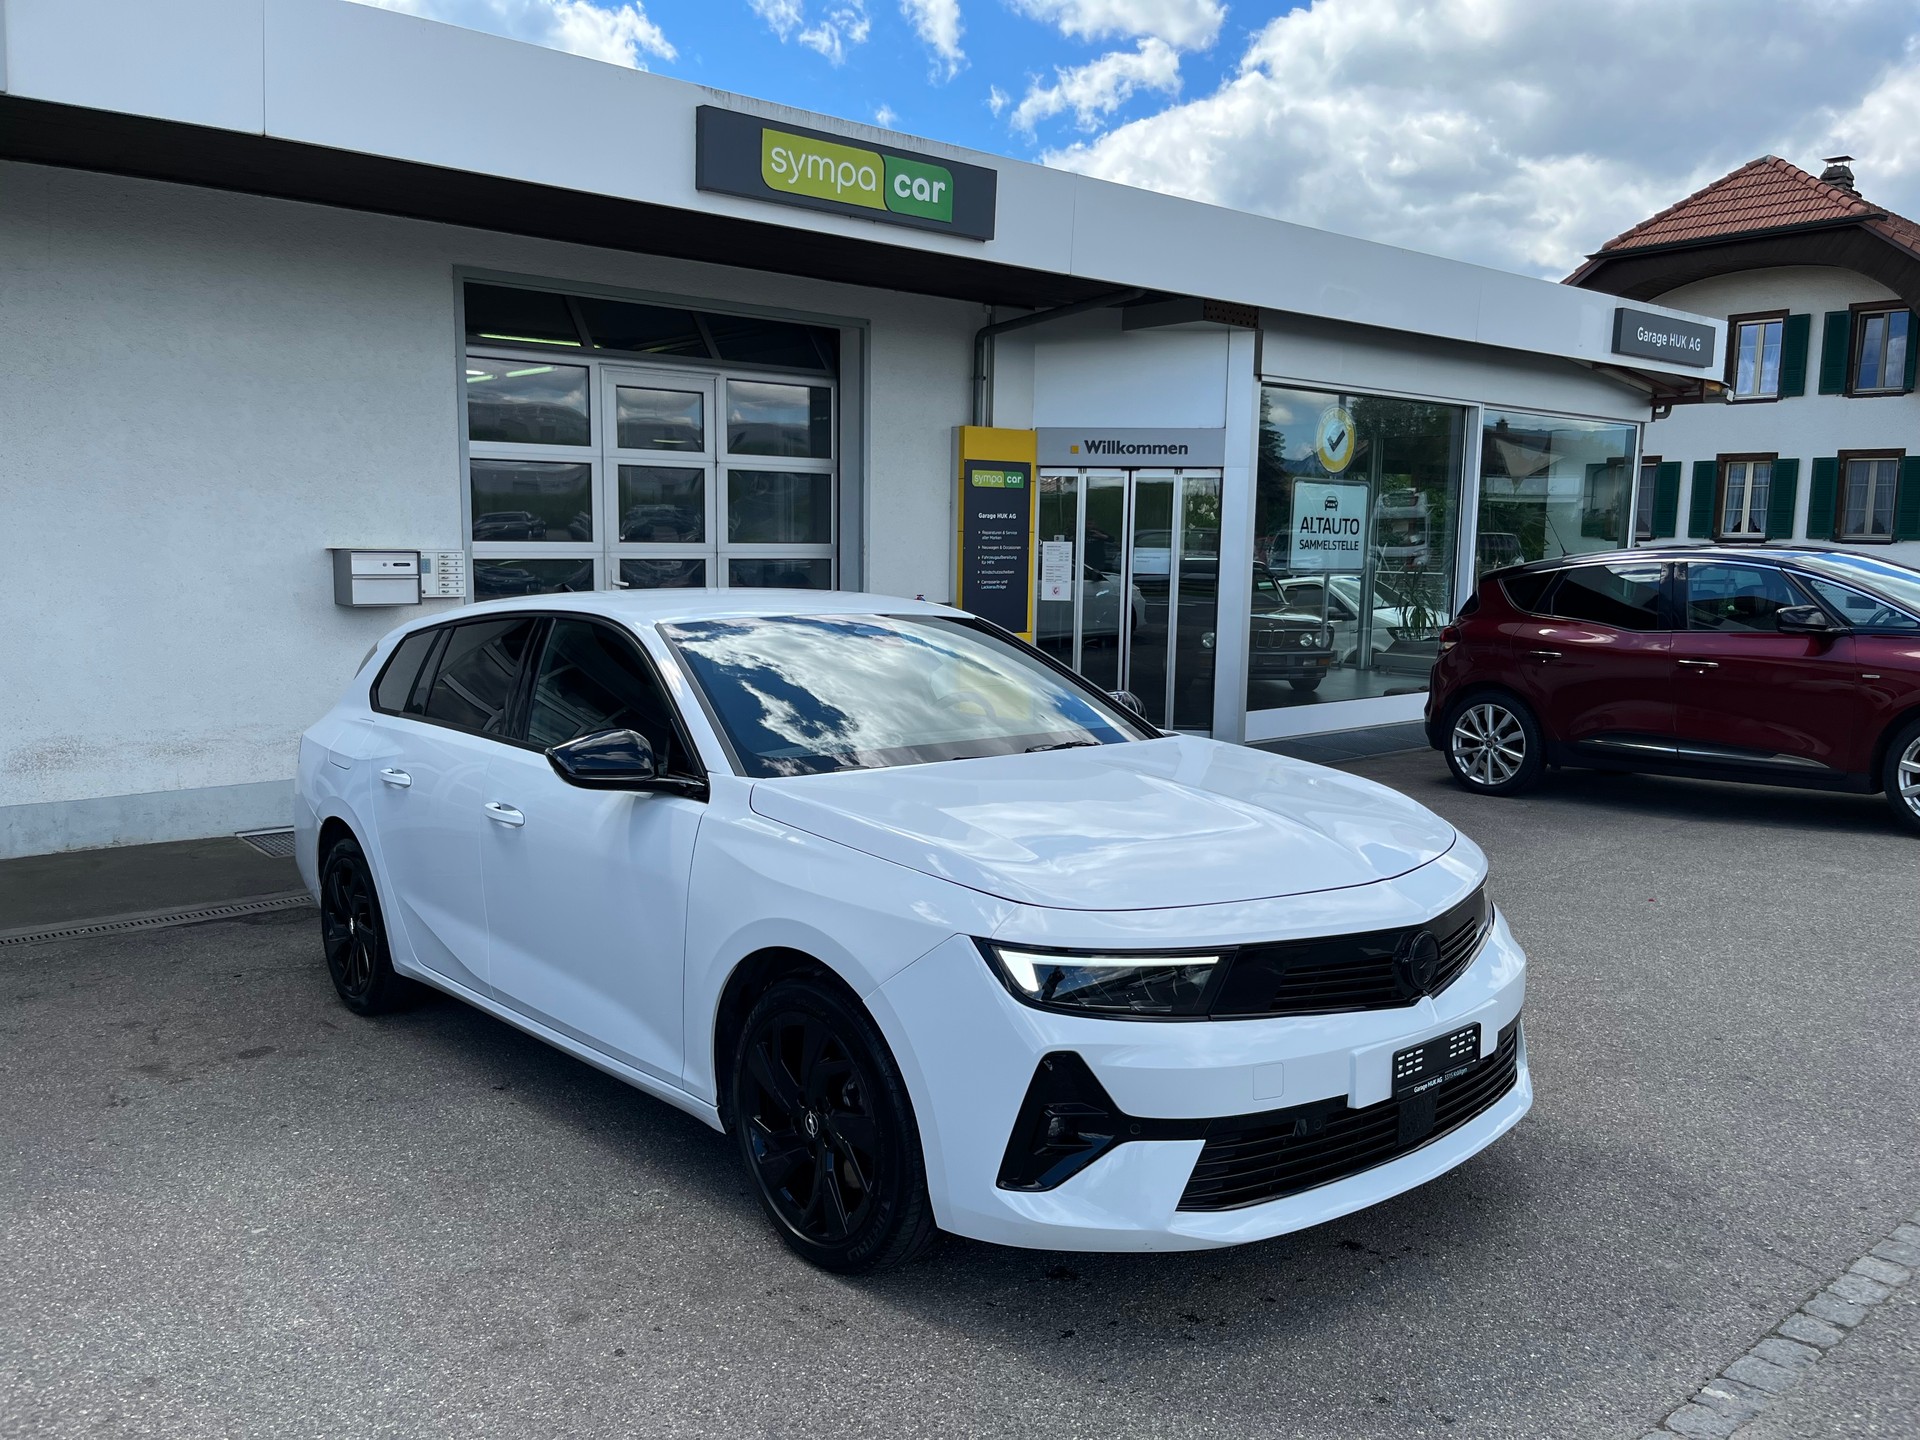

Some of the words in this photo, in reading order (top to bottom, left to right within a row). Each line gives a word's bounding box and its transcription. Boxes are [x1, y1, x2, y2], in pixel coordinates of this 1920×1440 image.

[771, 147, 876, 194] sympa
[893, 174, 946, 203] car
[1637, 326, 1667, 347] Garage
[1669, 333, 1687, 349] HUK
[1689, 337, 1701, 351] AG
[1084, 440, 1189, 455] Willkommen
[974, 474, 1003, 485] sympa
[1006, 476, 1022, 484] car
[978, 512, 996, 520] Garage
[1299, 516, 1360, 536] ALTAUTO
[1299, 539, 1359, 551] SAMMELSTELLE
[1414, 1084, 1427, 1093] Garage
[1428, 1079, 1437, 1087] HUK
